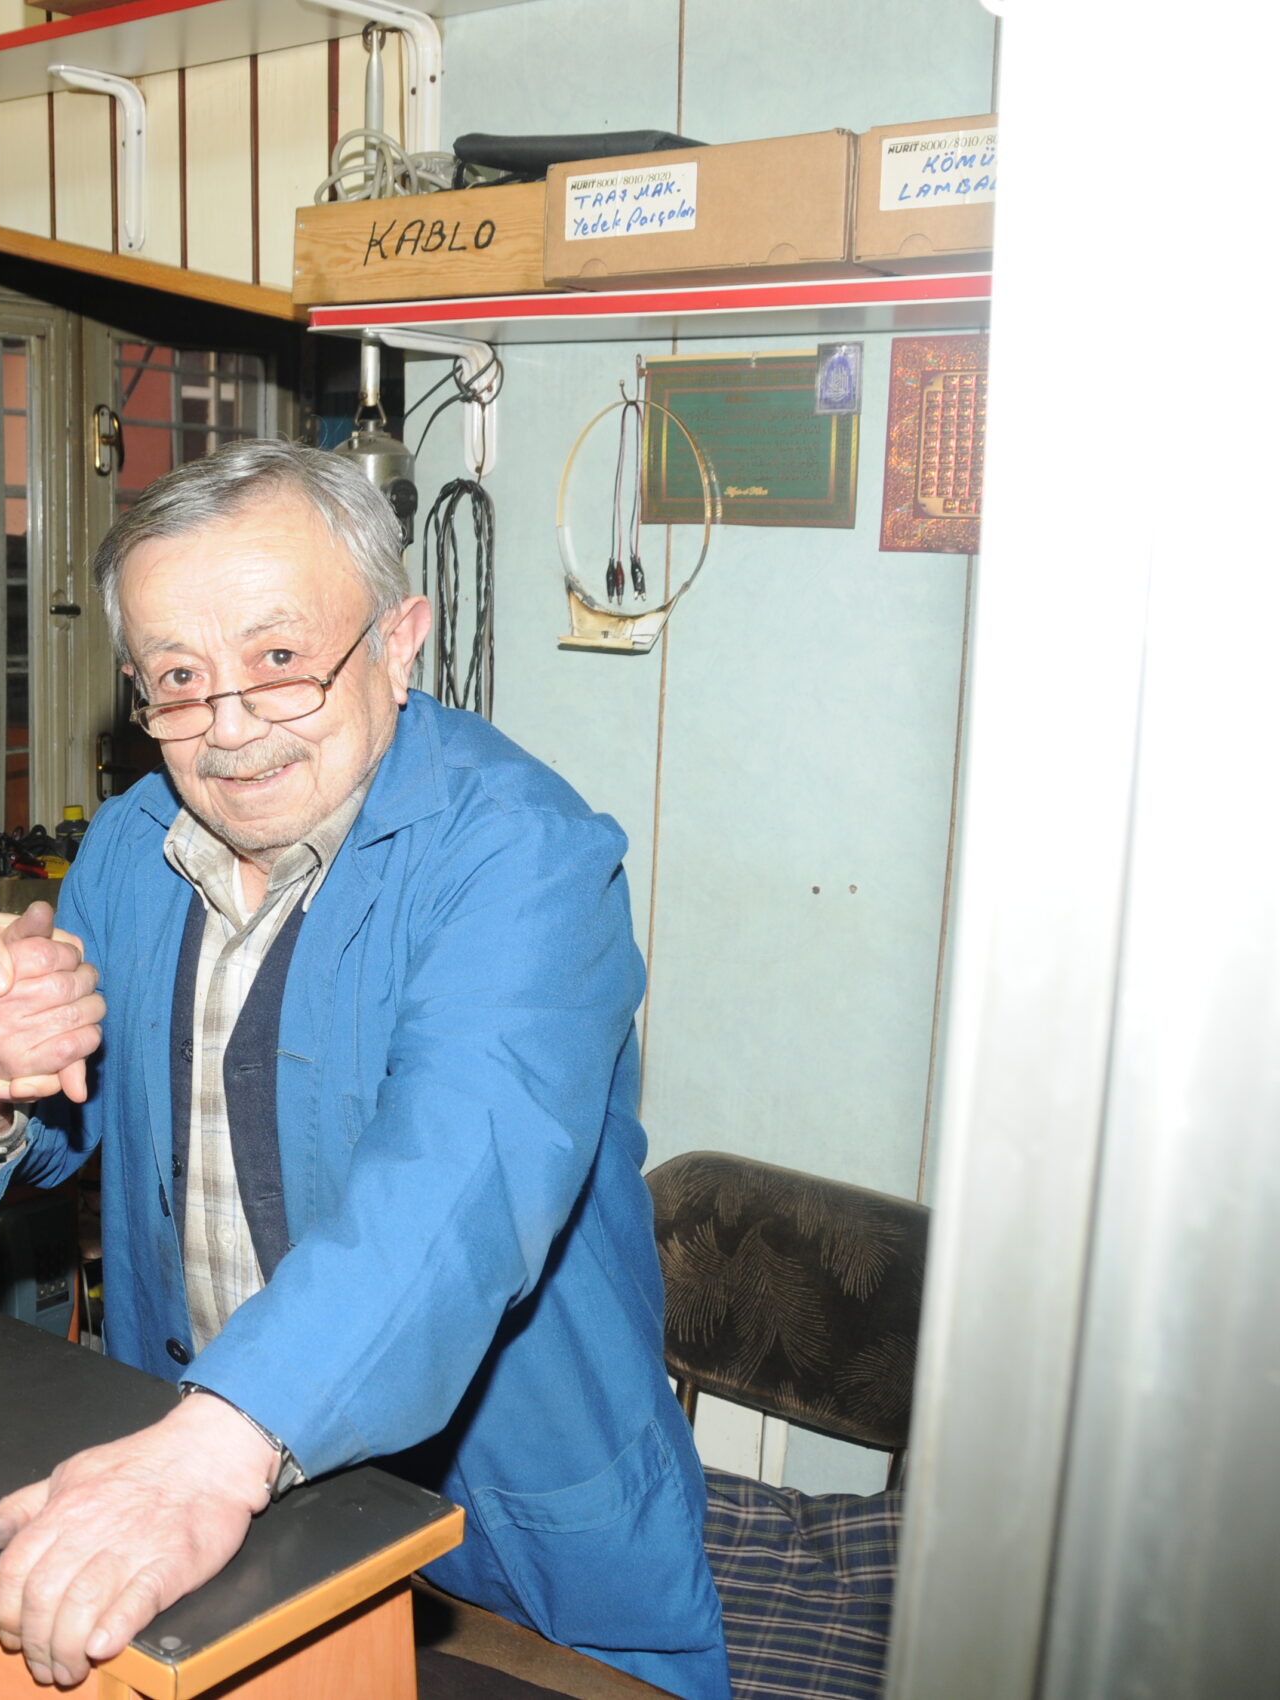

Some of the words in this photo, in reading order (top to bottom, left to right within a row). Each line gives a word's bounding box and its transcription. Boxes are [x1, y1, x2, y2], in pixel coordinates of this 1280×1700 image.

[888, 143, 920, 155] NURIT
[570, 180, 596, 191] NURIT
[573, 209, 621, 236] Yedek
[363, 219, 496, 267] KABLO
